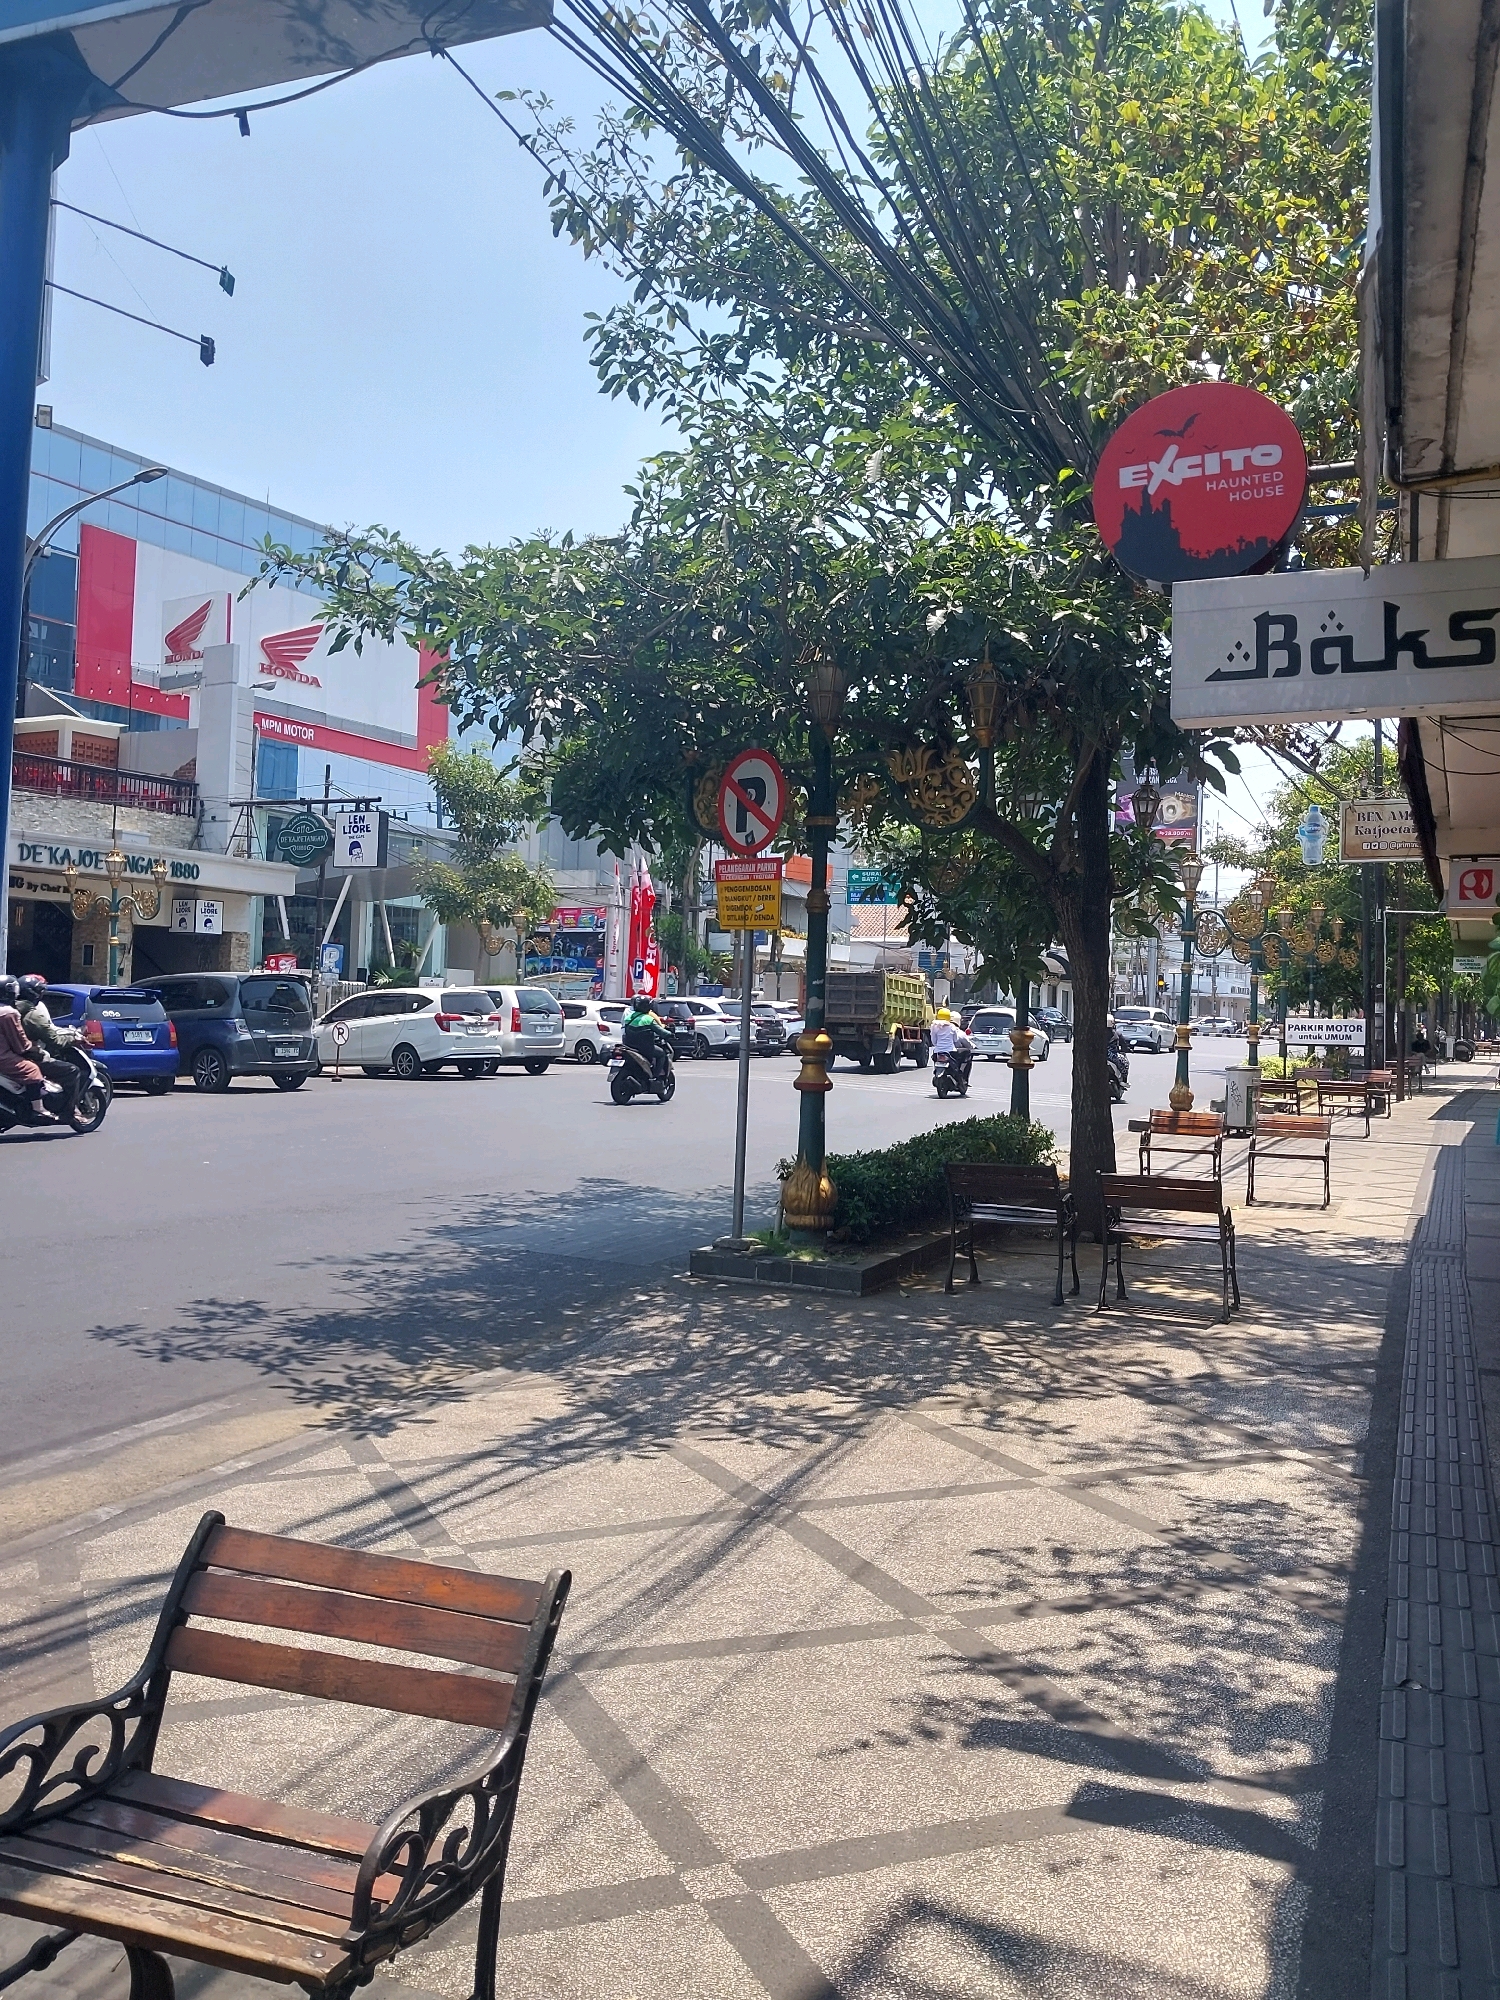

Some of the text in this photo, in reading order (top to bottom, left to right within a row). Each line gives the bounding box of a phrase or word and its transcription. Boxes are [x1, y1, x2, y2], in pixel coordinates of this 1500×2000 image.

[1119, 443, 1283, 495] EXCITO
[1206, 471, 1284, 492] HAUNTED
[1229, 484, 1284, 502] HOUSE
[258, 662, 322, 688] HONDA
[261, 717, 314, 741] MPM MOTOR
[348, 814, 366, 824] LEN
[1387, 810, 1415, 821] AM
[342, 823, 372, 835] LIORE
[170, 860, 200, 880] 1880
[757, 862, 777, 872] PARKIR
[26, 882, 39, 892] By
[724, 885, 772, 893] PENGGEMBOSAN
[1287, 1023, 1363, 1033] PARKIR MOTOR
[1298, 1033, 1323, 1041] untuk
